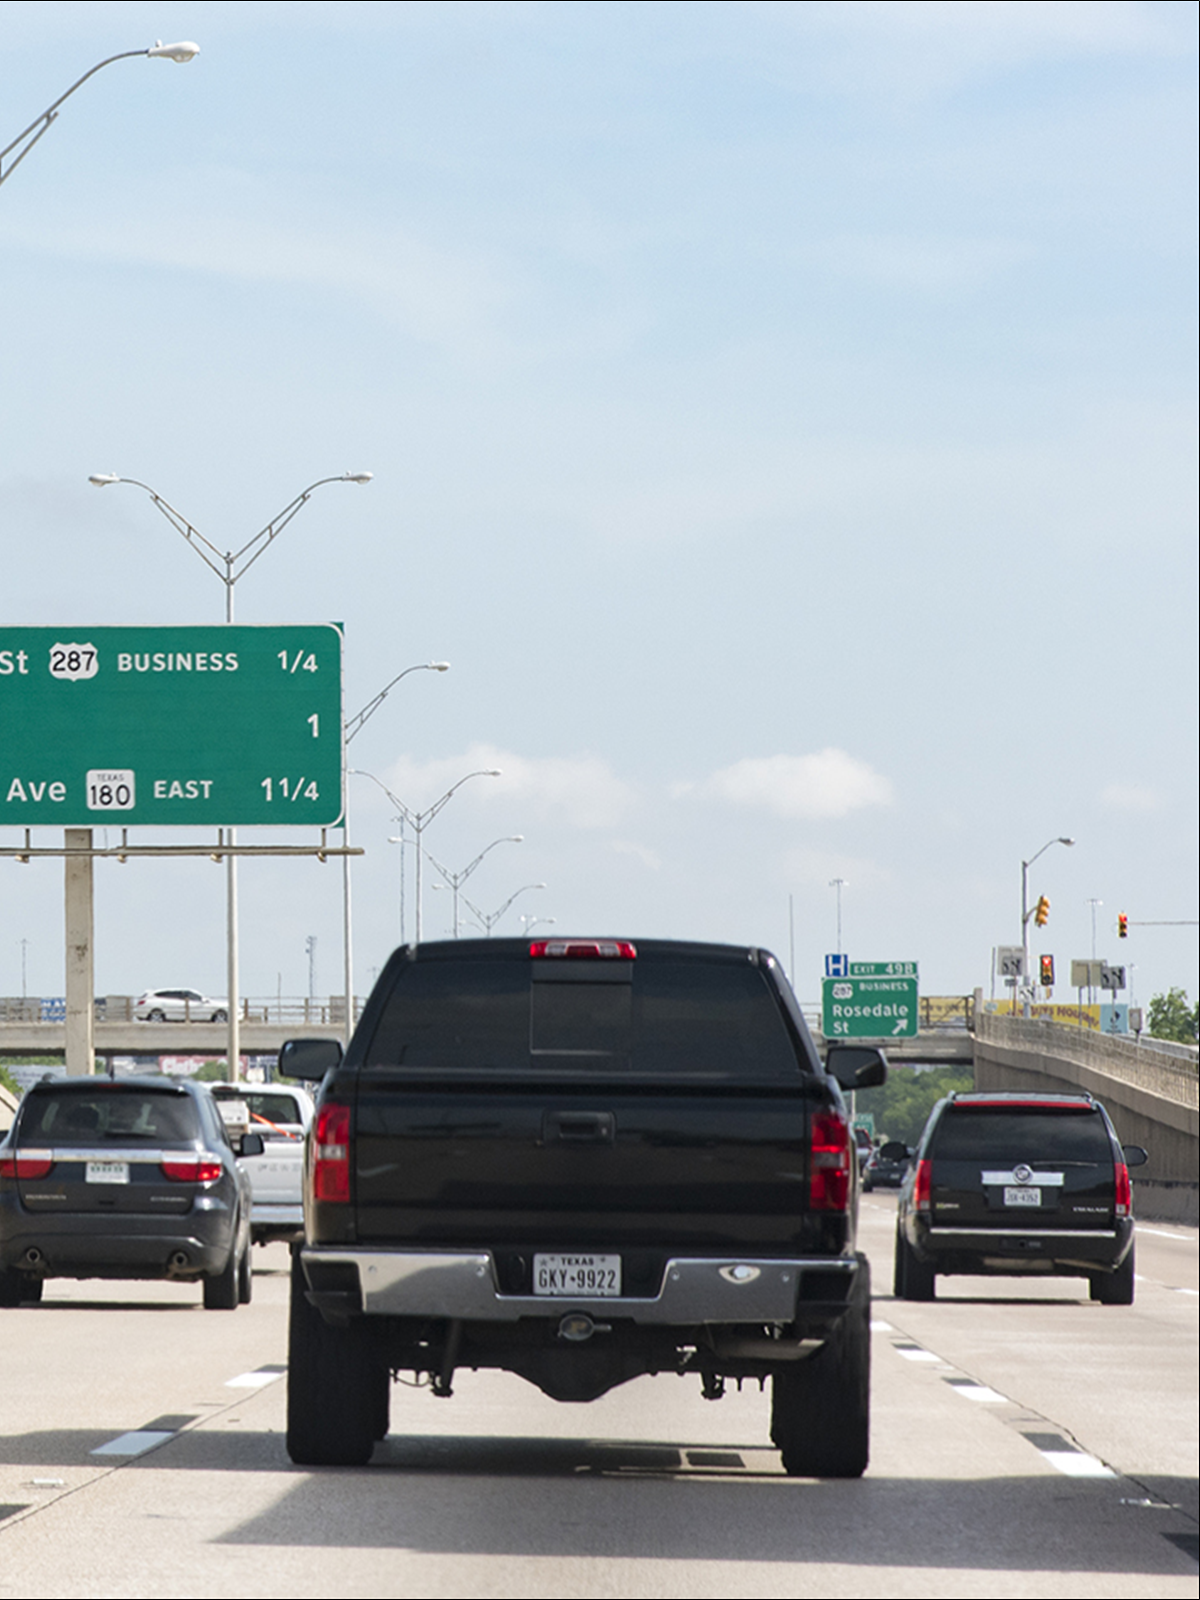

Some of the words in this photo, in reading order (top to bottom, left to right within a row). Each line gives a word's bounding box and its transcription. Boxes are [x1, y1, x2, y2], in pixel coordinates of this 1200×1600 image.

[52, 650, 95, 672] 287
[117, 653, 239, 672] BUSINESS
[277, 650, 318, 674] 1/4
[307, 713, 319, 738] 1
[97, 773, 125, 782] TEXAS
[6, 777, 67, 802] Ave
[90, 784, 131, 806] 180
[154, 780, 213, 799] EAST
[828, 955, 845, 977] H
[853, 965, 875, 974] EXIT
[885, 963, 914, 975] 49B
[859, 982, 909, 992] BUSINESS
[832, 1003, 909, 1018] Rosedale
[833, 1021, 849, 1034] St
[561, 1257, 594, 1266] TEXAS
